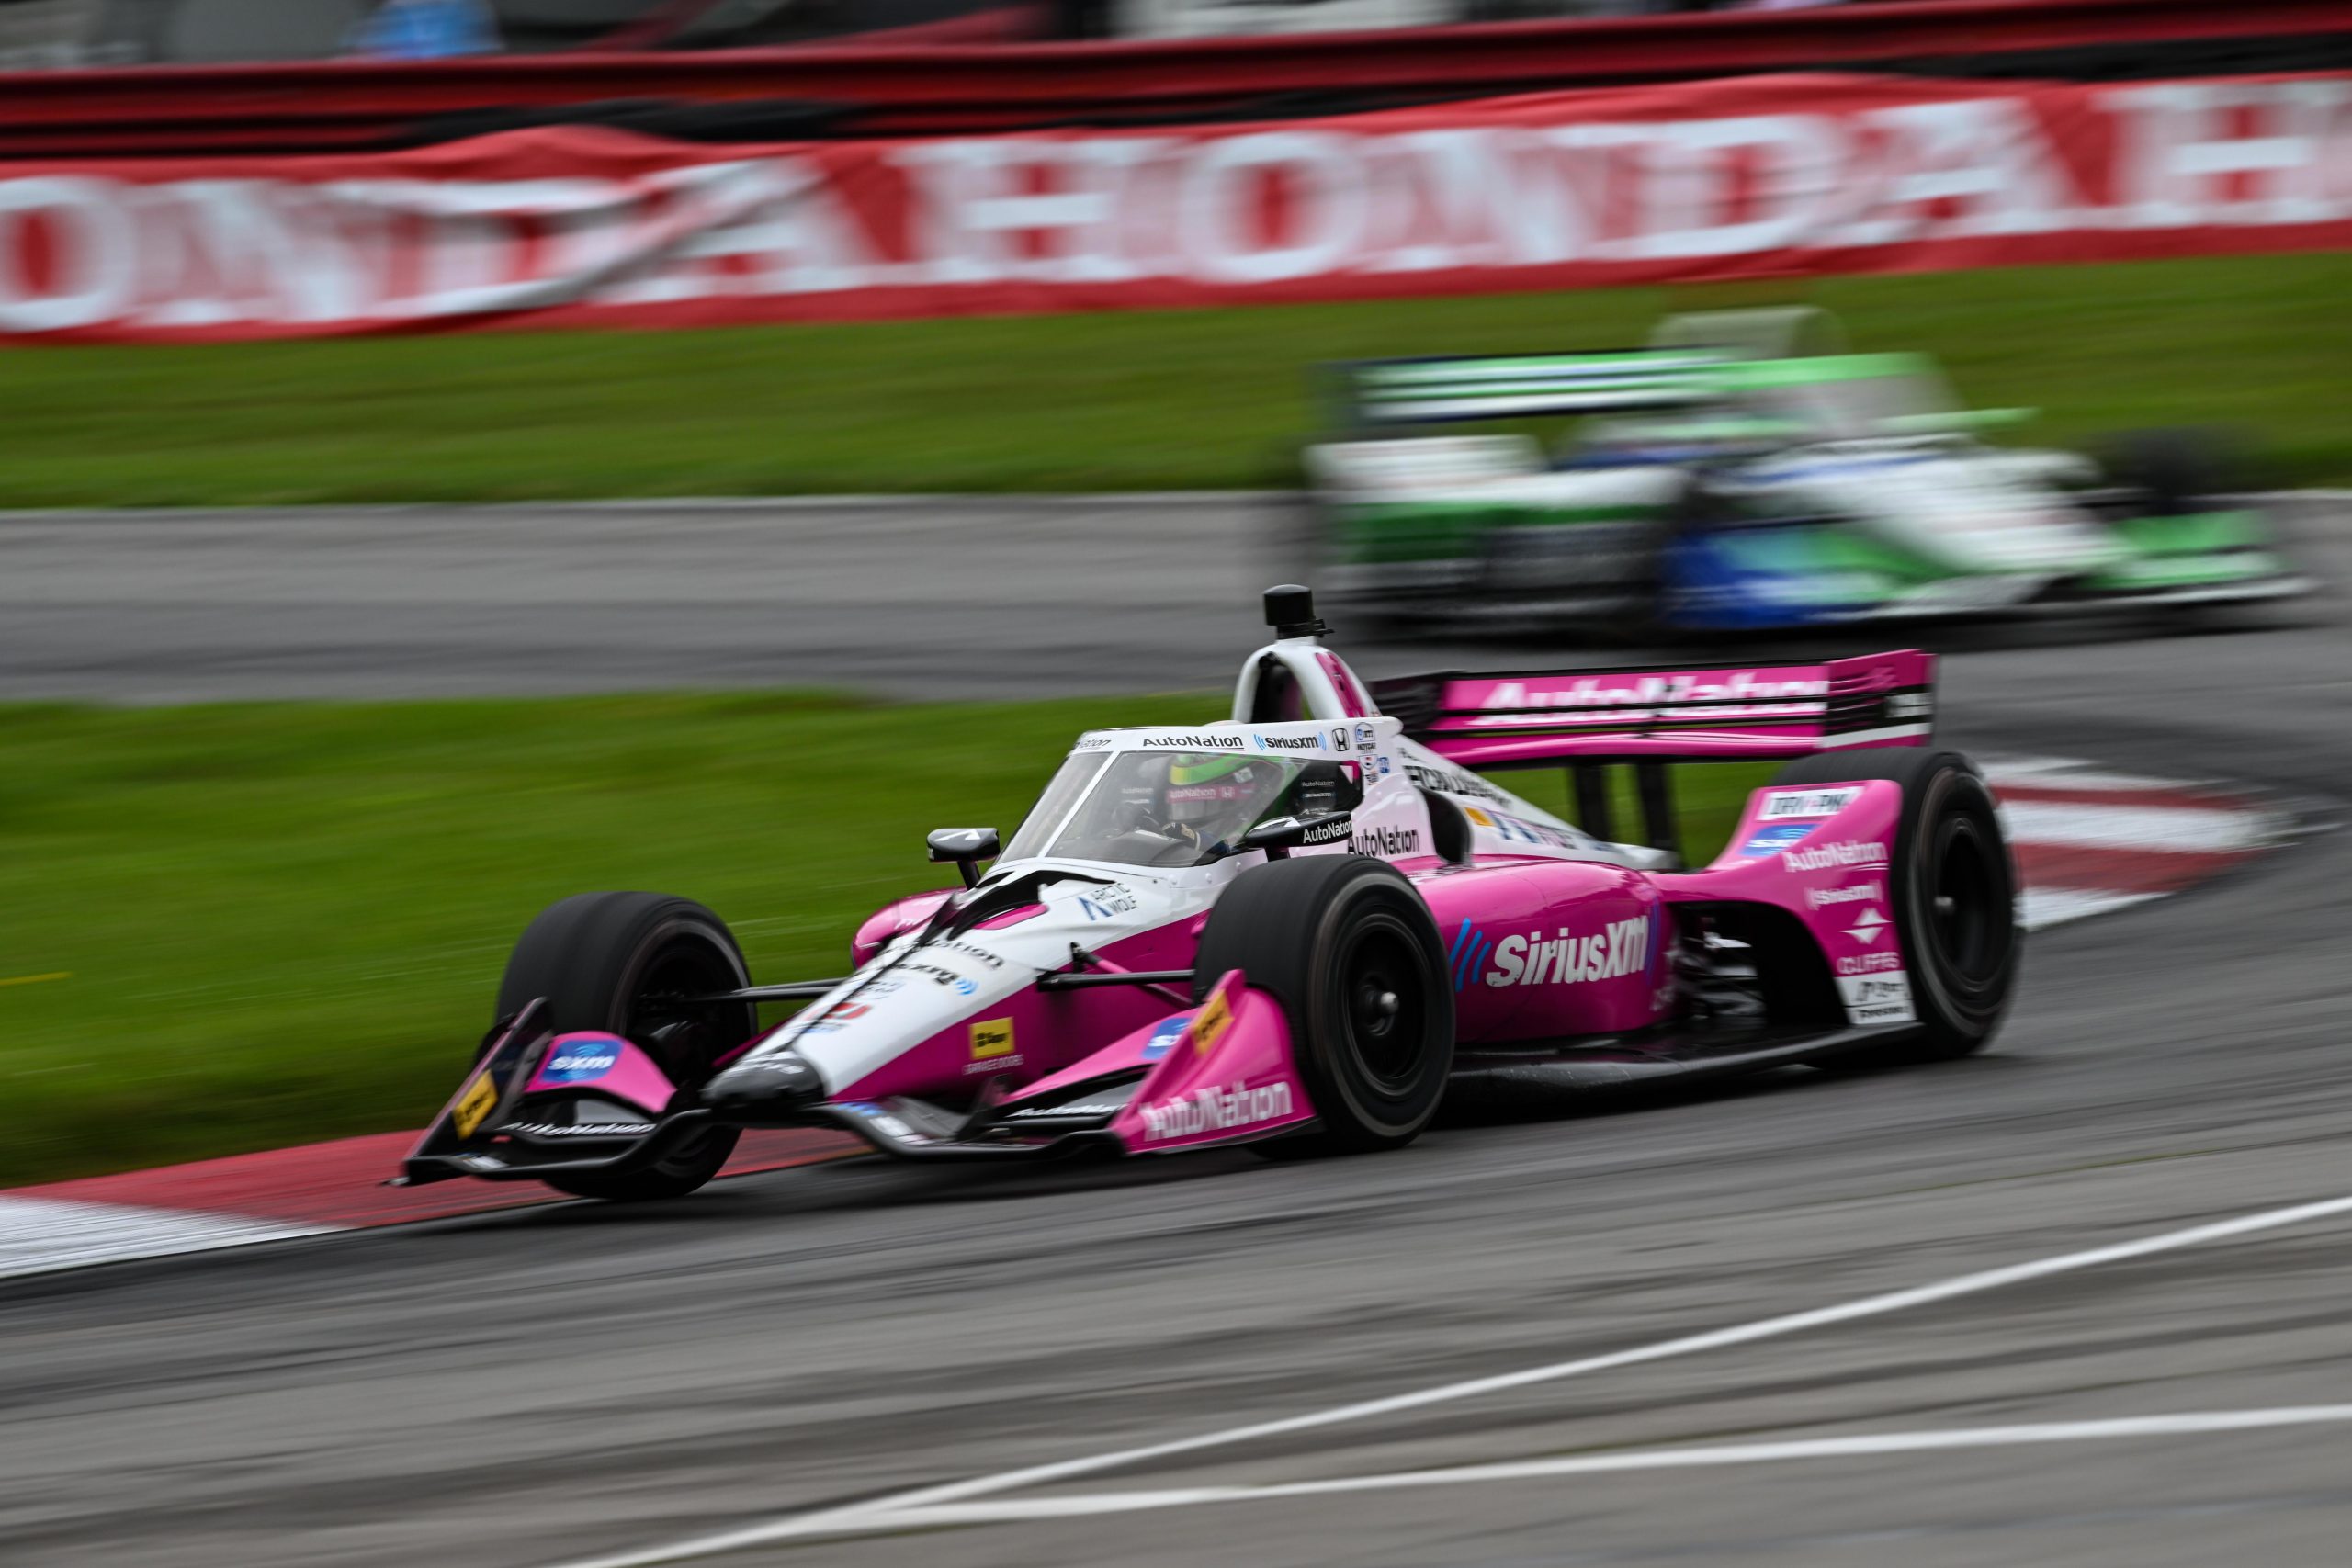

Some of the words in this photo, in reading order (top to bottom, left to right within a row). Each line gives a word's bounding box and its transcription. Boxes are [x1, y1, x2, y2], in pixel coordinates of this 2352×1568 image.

[884, 96, 2104, 286] HONDA
[1482, 670, 1829, 710] AutoNation
[1142, 735, 1244, 749] AutoNation
[1303, 819, 1352, 843] AutoNation
[1347, 825, 1419, 857] AutoNation
[1782, 840, 1889, 873] AutoNation
[1106, 895, 1138, 914] WOLF
[1139, 1079, 1294, 1143] AutoNation
[495, 1121, 656, 1136] AutoNation
